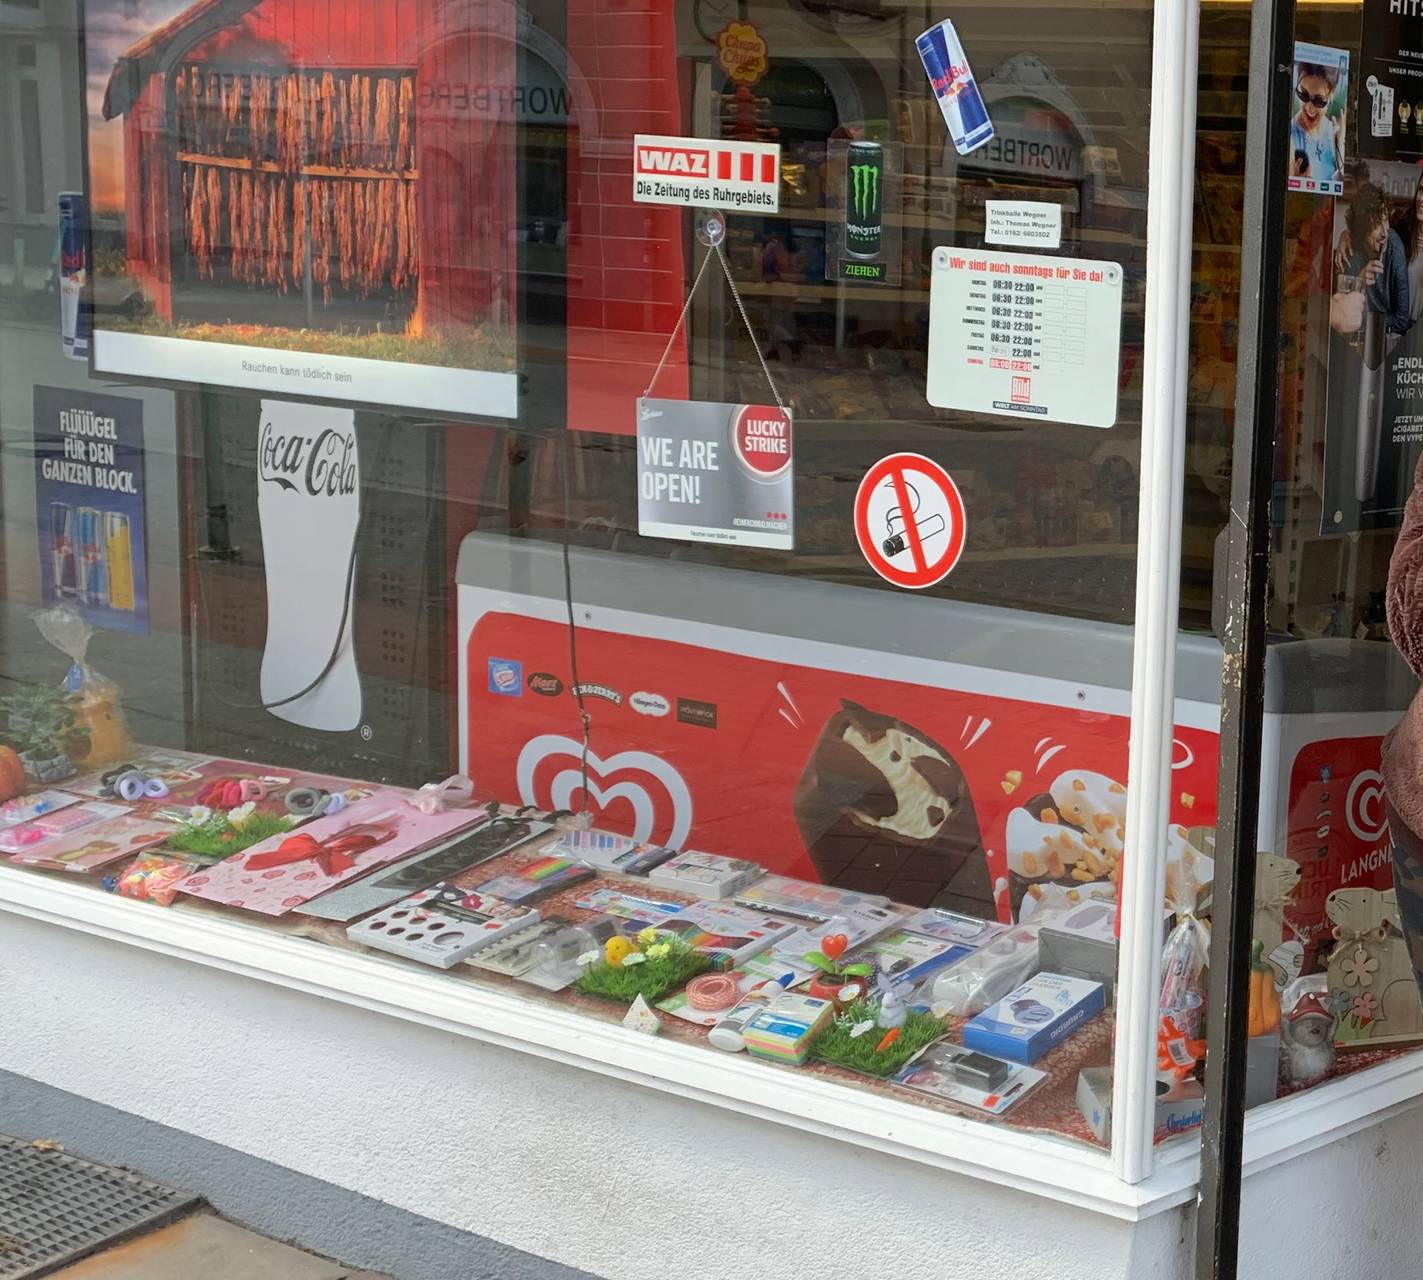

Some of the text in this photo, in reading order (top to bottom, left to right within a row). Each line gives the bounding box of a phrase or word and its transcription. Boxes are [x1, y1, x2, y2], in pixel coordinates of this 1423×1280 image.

[1398, 49, 1410, 57] DER
[932, 59, 970, 92] Red Bull
[1388, 66, 1407, 75] UNSER
[639, 150, 707, 174] WAZ
[636, 181, 775, 206] Die Zeitung des Ruhrgebiets.
[990, 208, 1047, 220] Trinkhalle Wegner
[847, 223, 880, 236] MONSTER
[990, 228, 1004, 236] Tel.:
[1005, 219, 1030, 228] Thomas
[1031, 221, 1056, 231] Wegner
[845, 264, 880, 277] ZIEHEN
[949, 256, 1104, 283] Wir sind auch sonntags für Sie da!
[241, 361, 352, 382] Rauchen kann tödlich sein
[1395, 388, 1415, 400] WIR
[1019, 404, 1046, 413] SONNTAG
[59, 408, 118, 440] FLÜÜÜGEL
[746, 419, 786, 437] LUCKY
[1394, 415, 1412, 424] JETZT
[744, 436, 787, 454] STRIKE
[1392, 433, 1406, 443] DEN
[1406, 433, 1423, 442] VYPE
[64, 434, 114, 466] FÜR DEN
[260, 421, 357, 497] Coca-Cola
[641, 436, 719, 471] WE ARE
[42, 457, 137, 494] GANZEN BLOCK.
[641, 471, 701, 505] OPEN!
[1050, 1010, 1084, 1039] GRUNDIG
